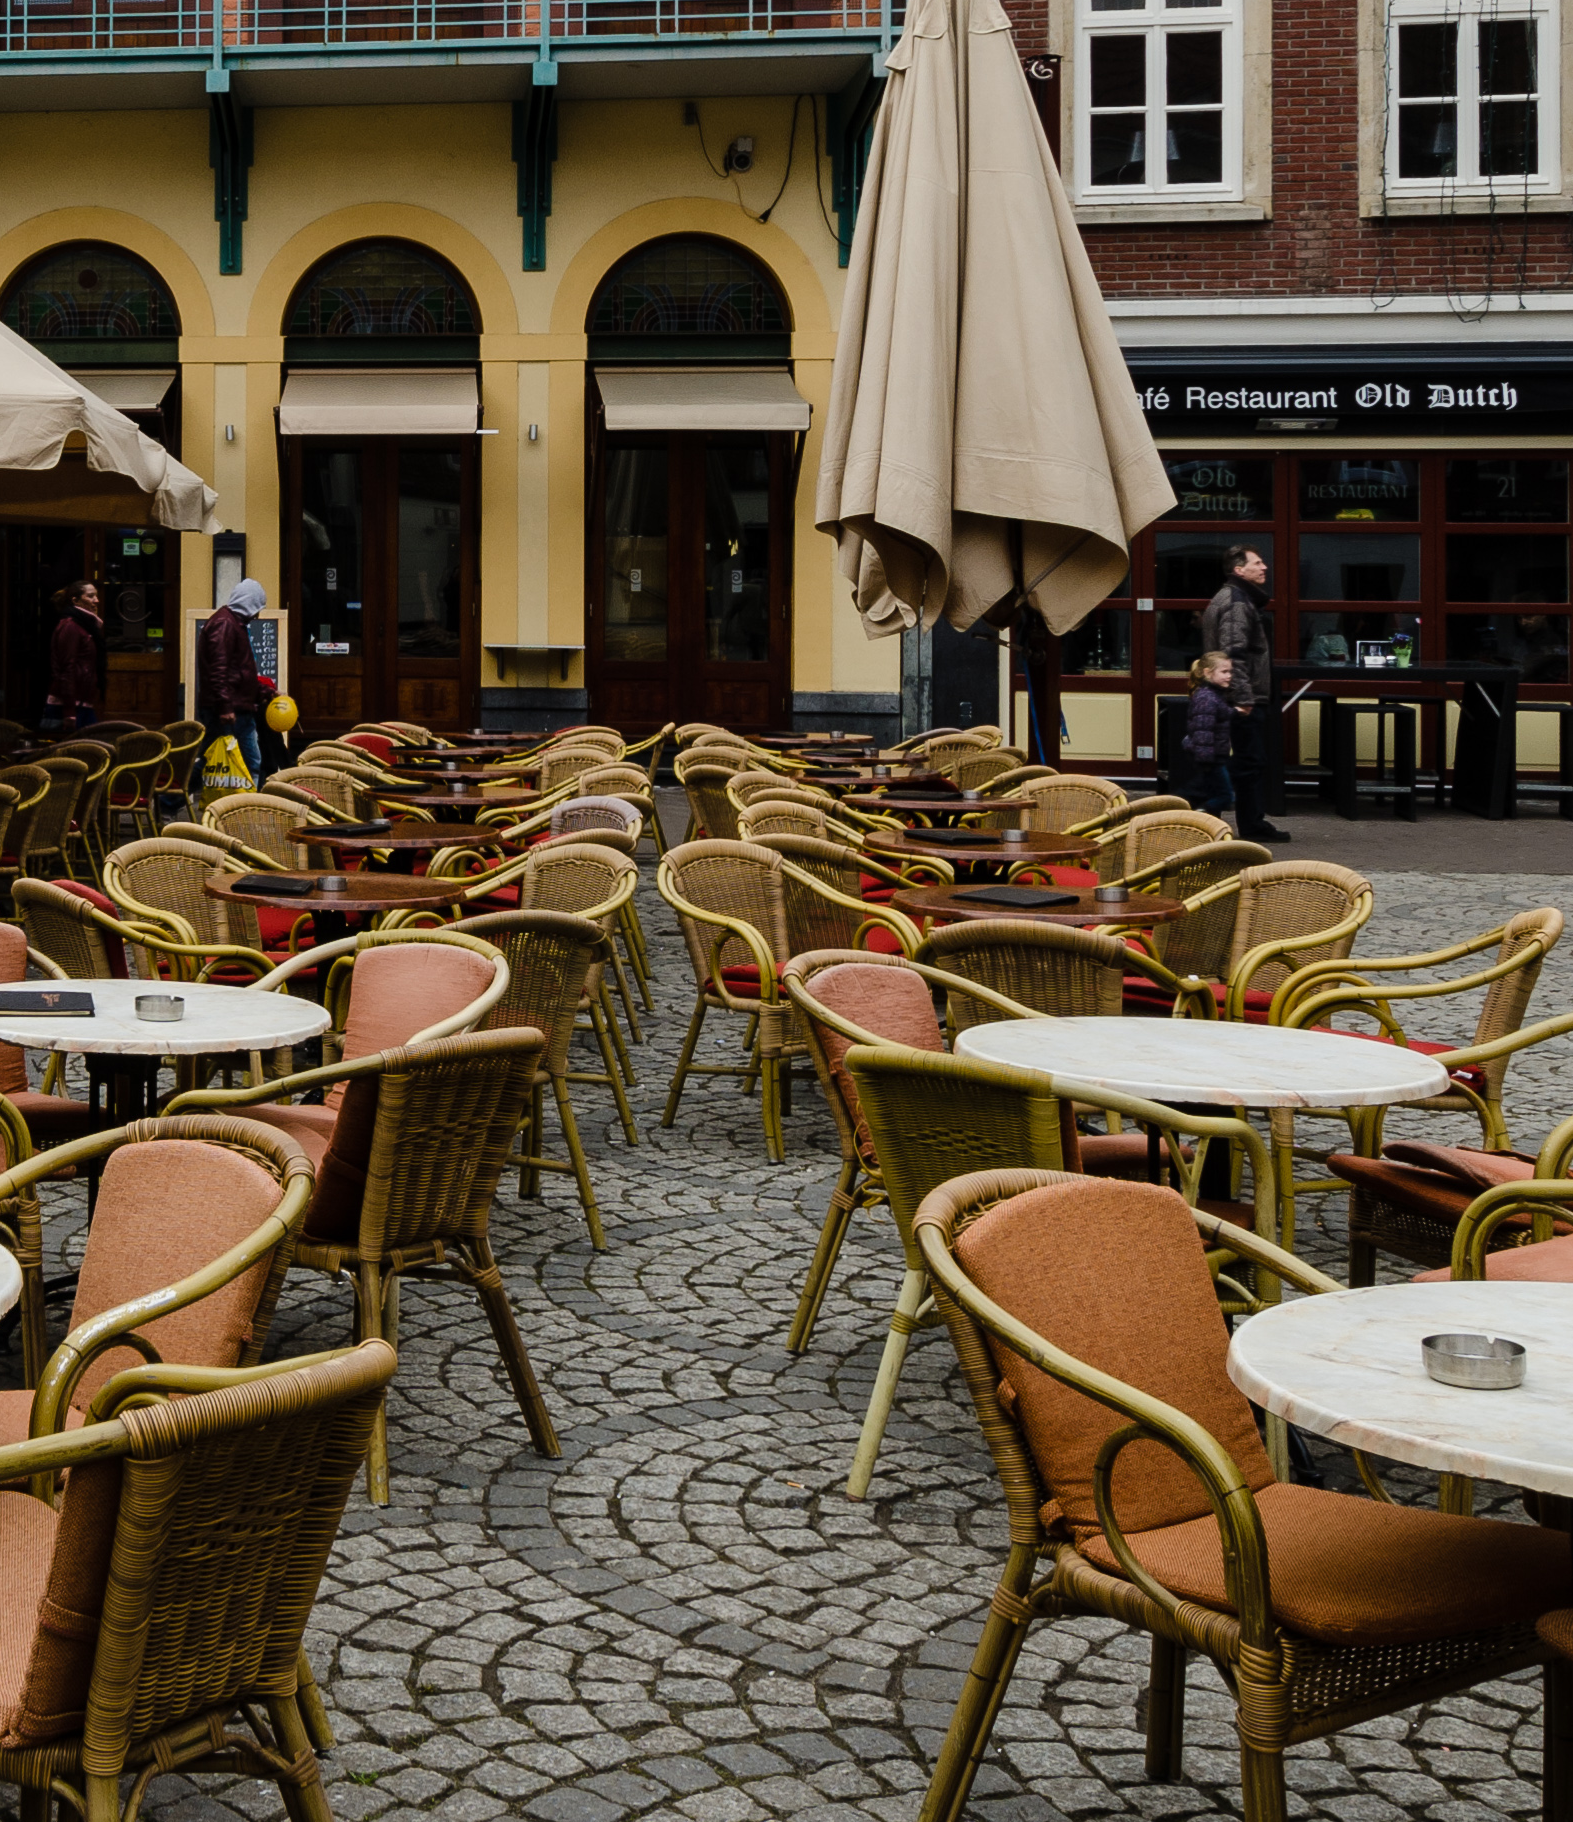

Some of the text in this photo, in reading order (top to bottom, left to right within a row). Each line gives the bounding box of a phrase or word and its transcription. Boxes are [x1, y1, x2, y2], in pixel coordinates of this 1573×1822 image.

[1186, 386, 1338, 410] Restaurant
[1355, 382, 1411, 409] Old
[1427, 382, 1519, 411] Dutch
[1192, 466, 1236, 489] Old
[1496, 476, 1516, 498] 21
[1180, 490, 1249, 514] Dutch
[1308, 482, 1409, 499] RESTAURANT
